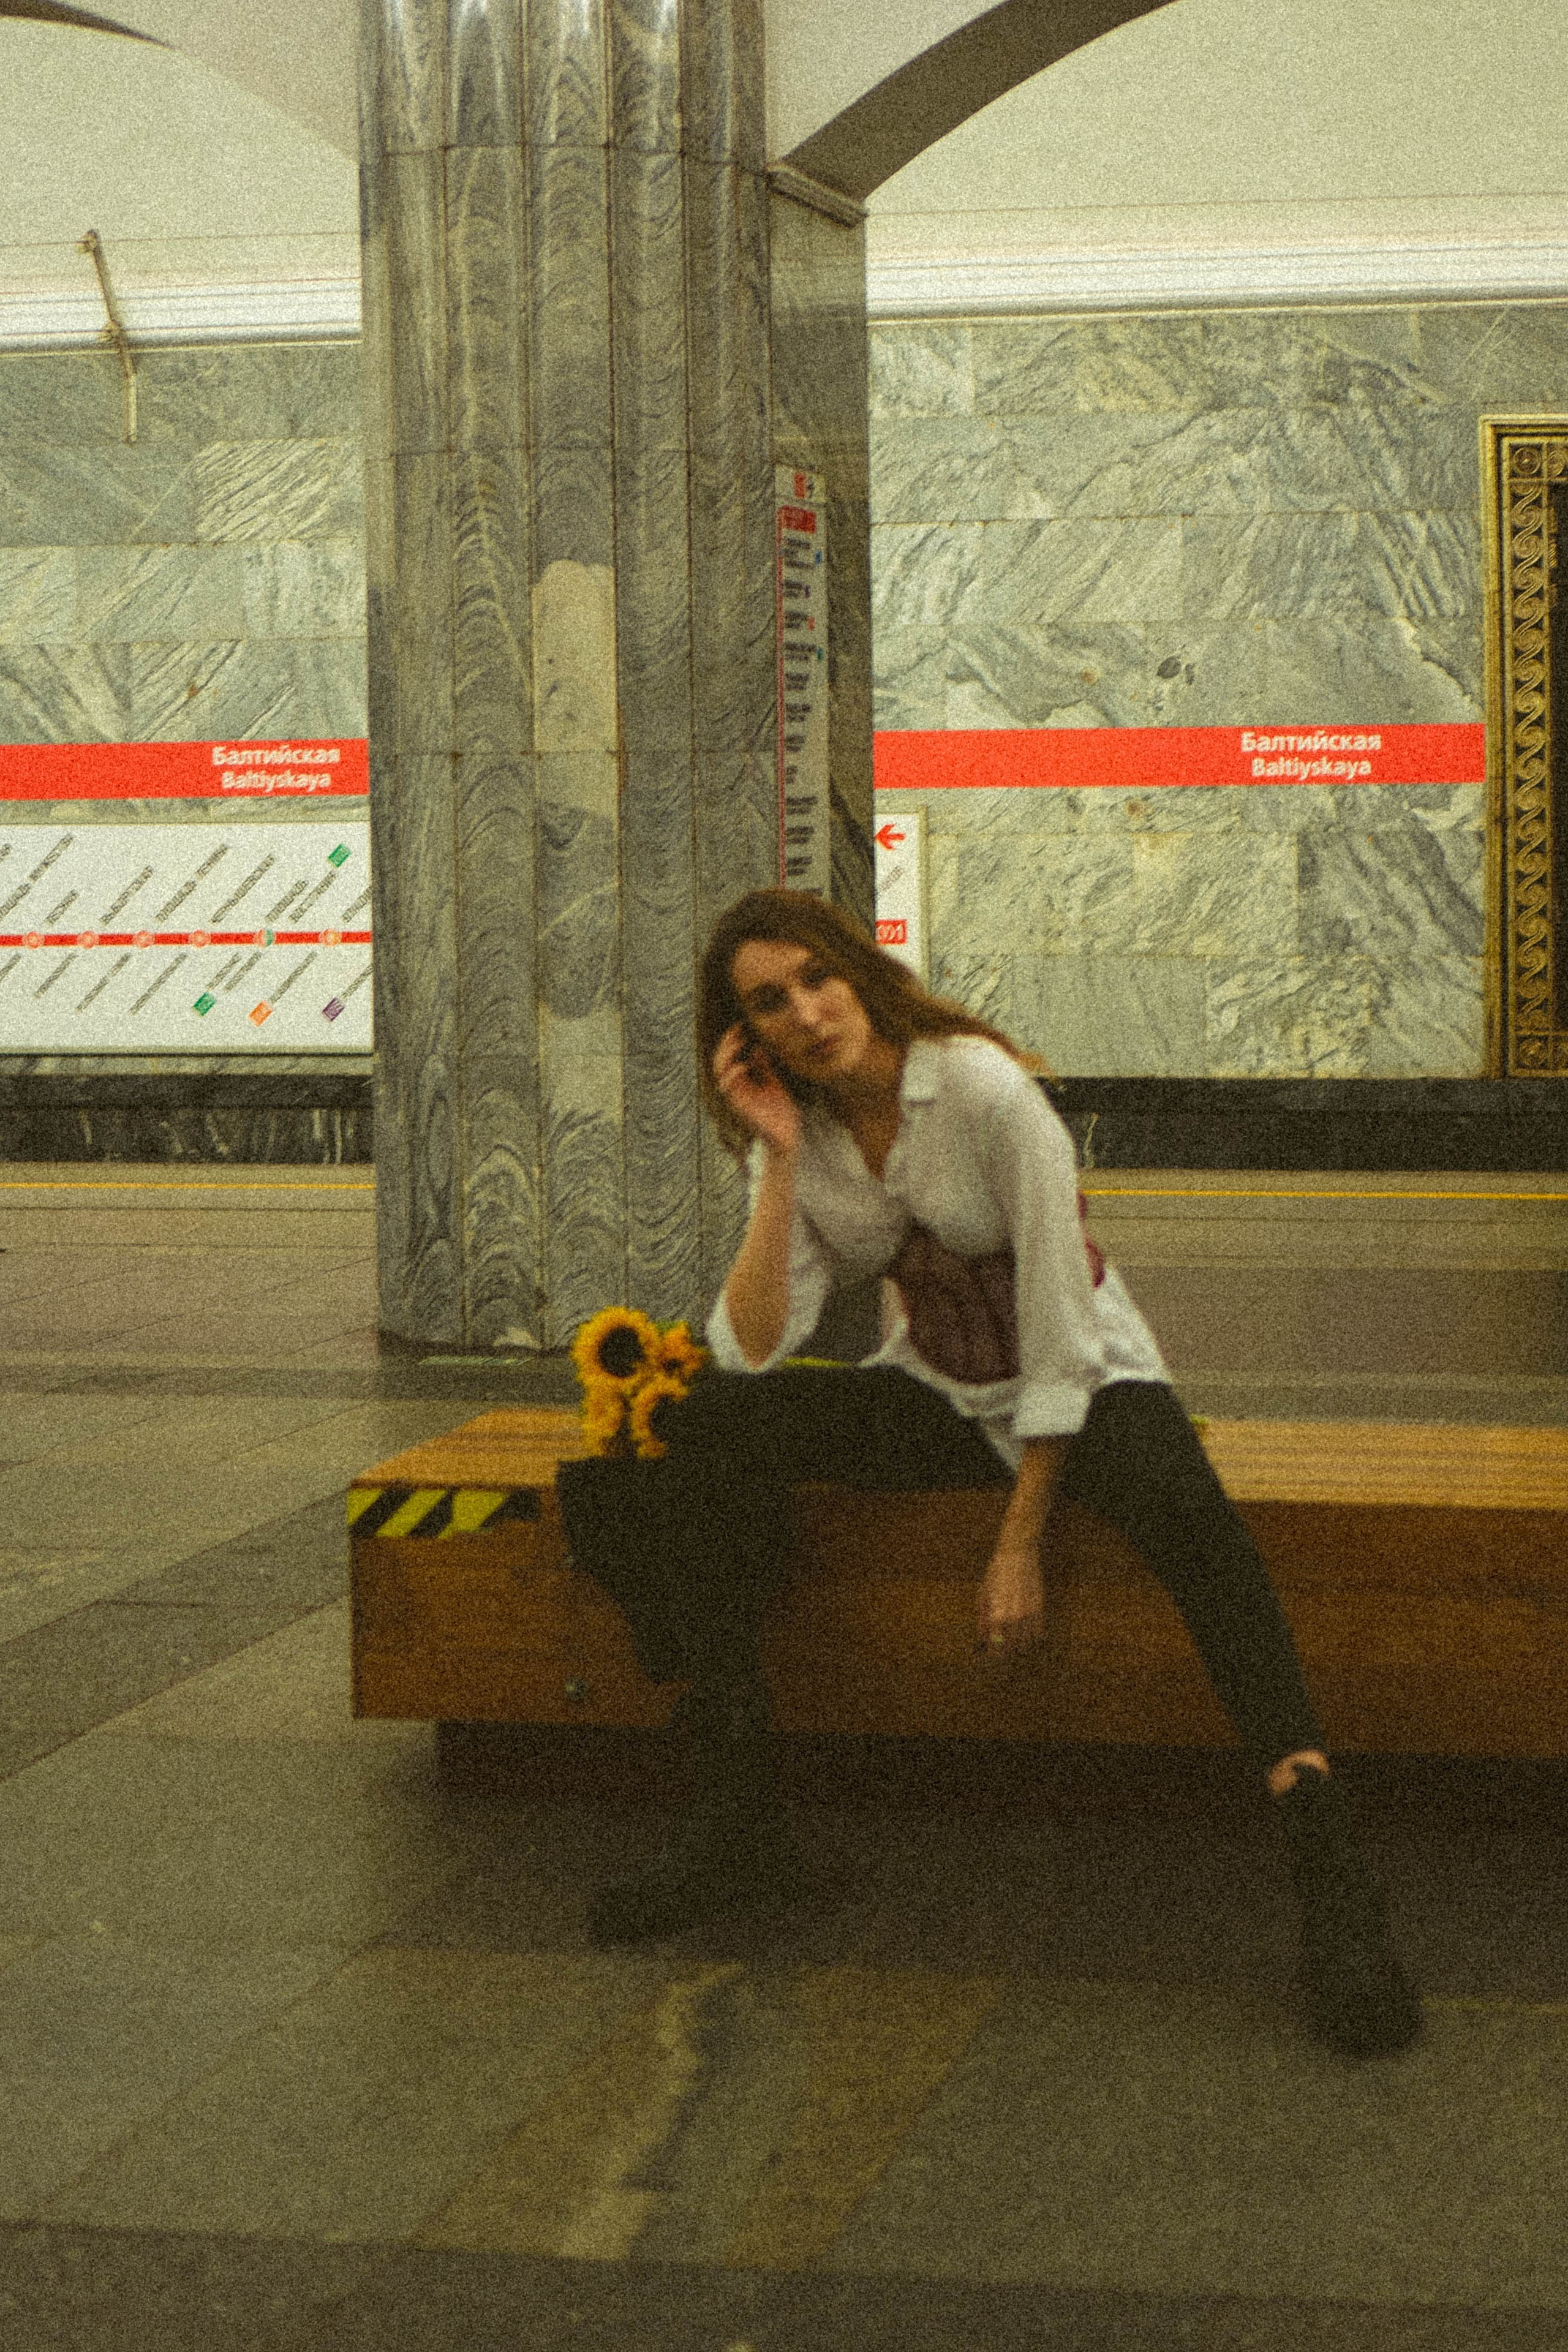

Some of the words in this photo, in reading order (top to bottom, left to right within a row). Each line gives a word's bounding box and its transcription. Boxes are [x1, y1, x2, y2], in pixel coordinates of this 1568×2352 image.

[1241, 729, 1382, 752] Балтийская
[212, 744, 341, 766] Балтийская
[1251, 756, 1372, 780] Baltiyskaya
[222, 769, 331, 793] Baltiyskaya
